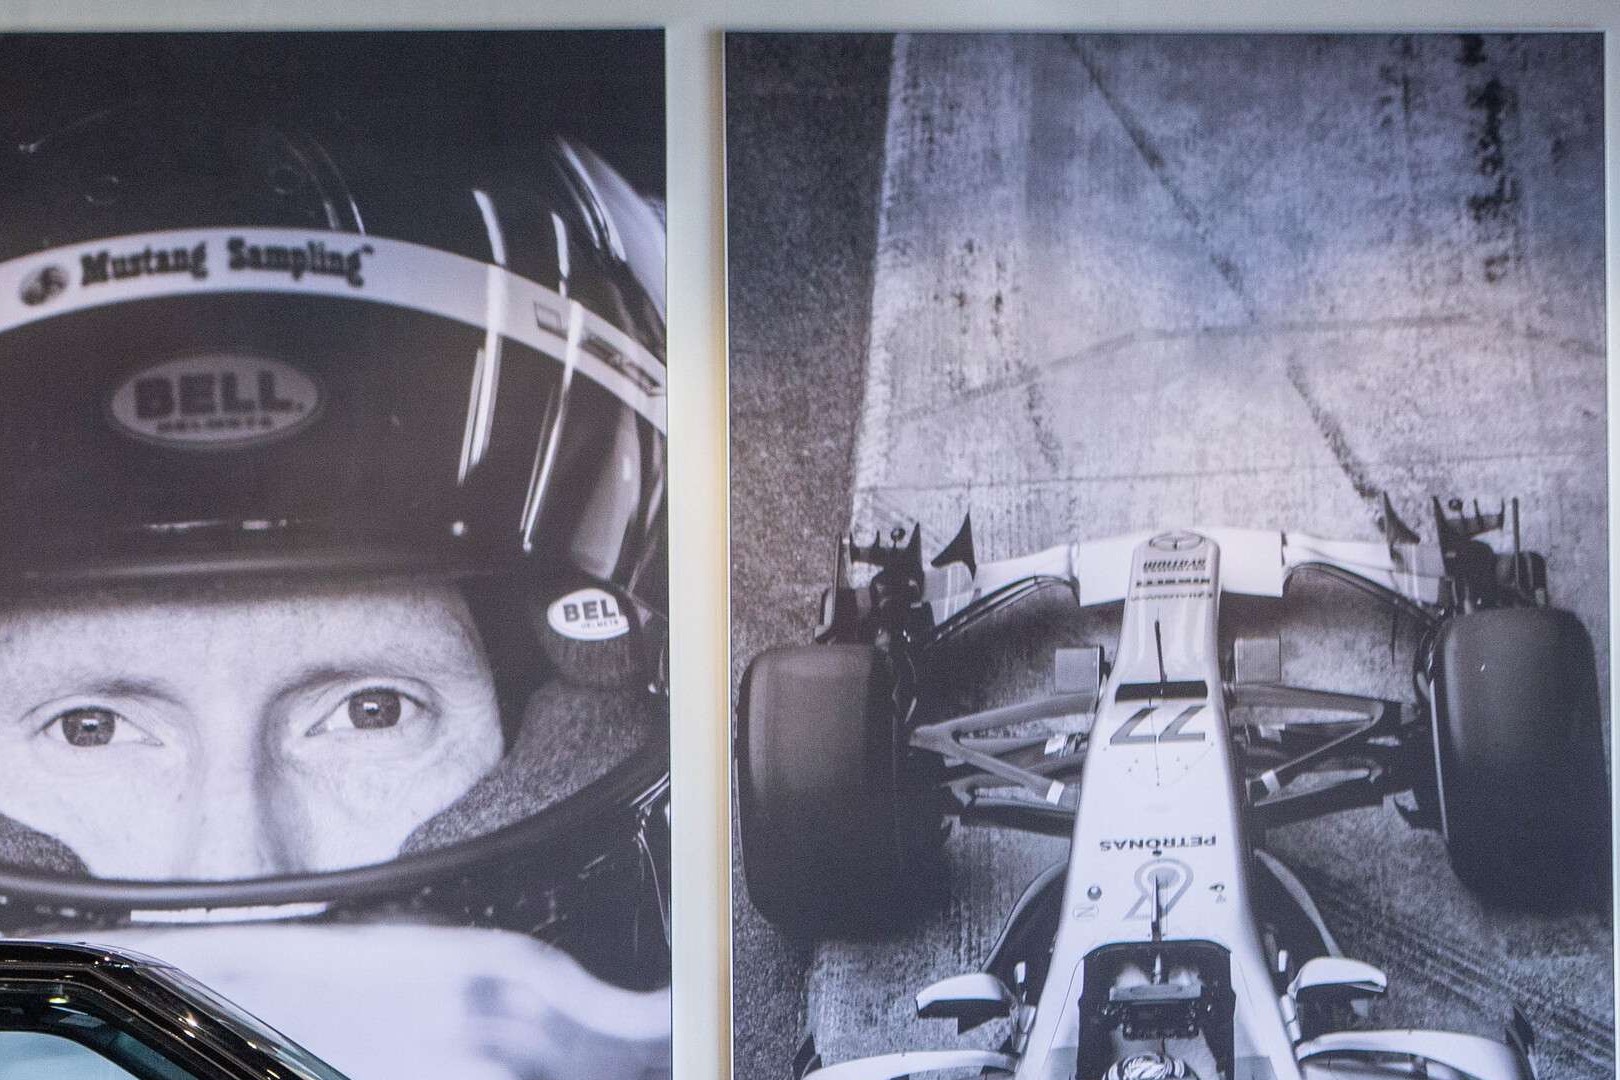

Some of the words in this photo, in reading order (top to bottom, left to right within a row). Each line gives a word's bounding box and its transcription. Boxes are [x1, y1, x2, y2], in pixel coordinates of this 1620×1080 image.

[82, 241, 209, 286] Mustang
[134, 370, 295, 420] BELL
[563, 599, 616, 622] BEL
[1109, 704, 1207, 745] 77
[1099, 835, 1217, 852] PETRONAS
